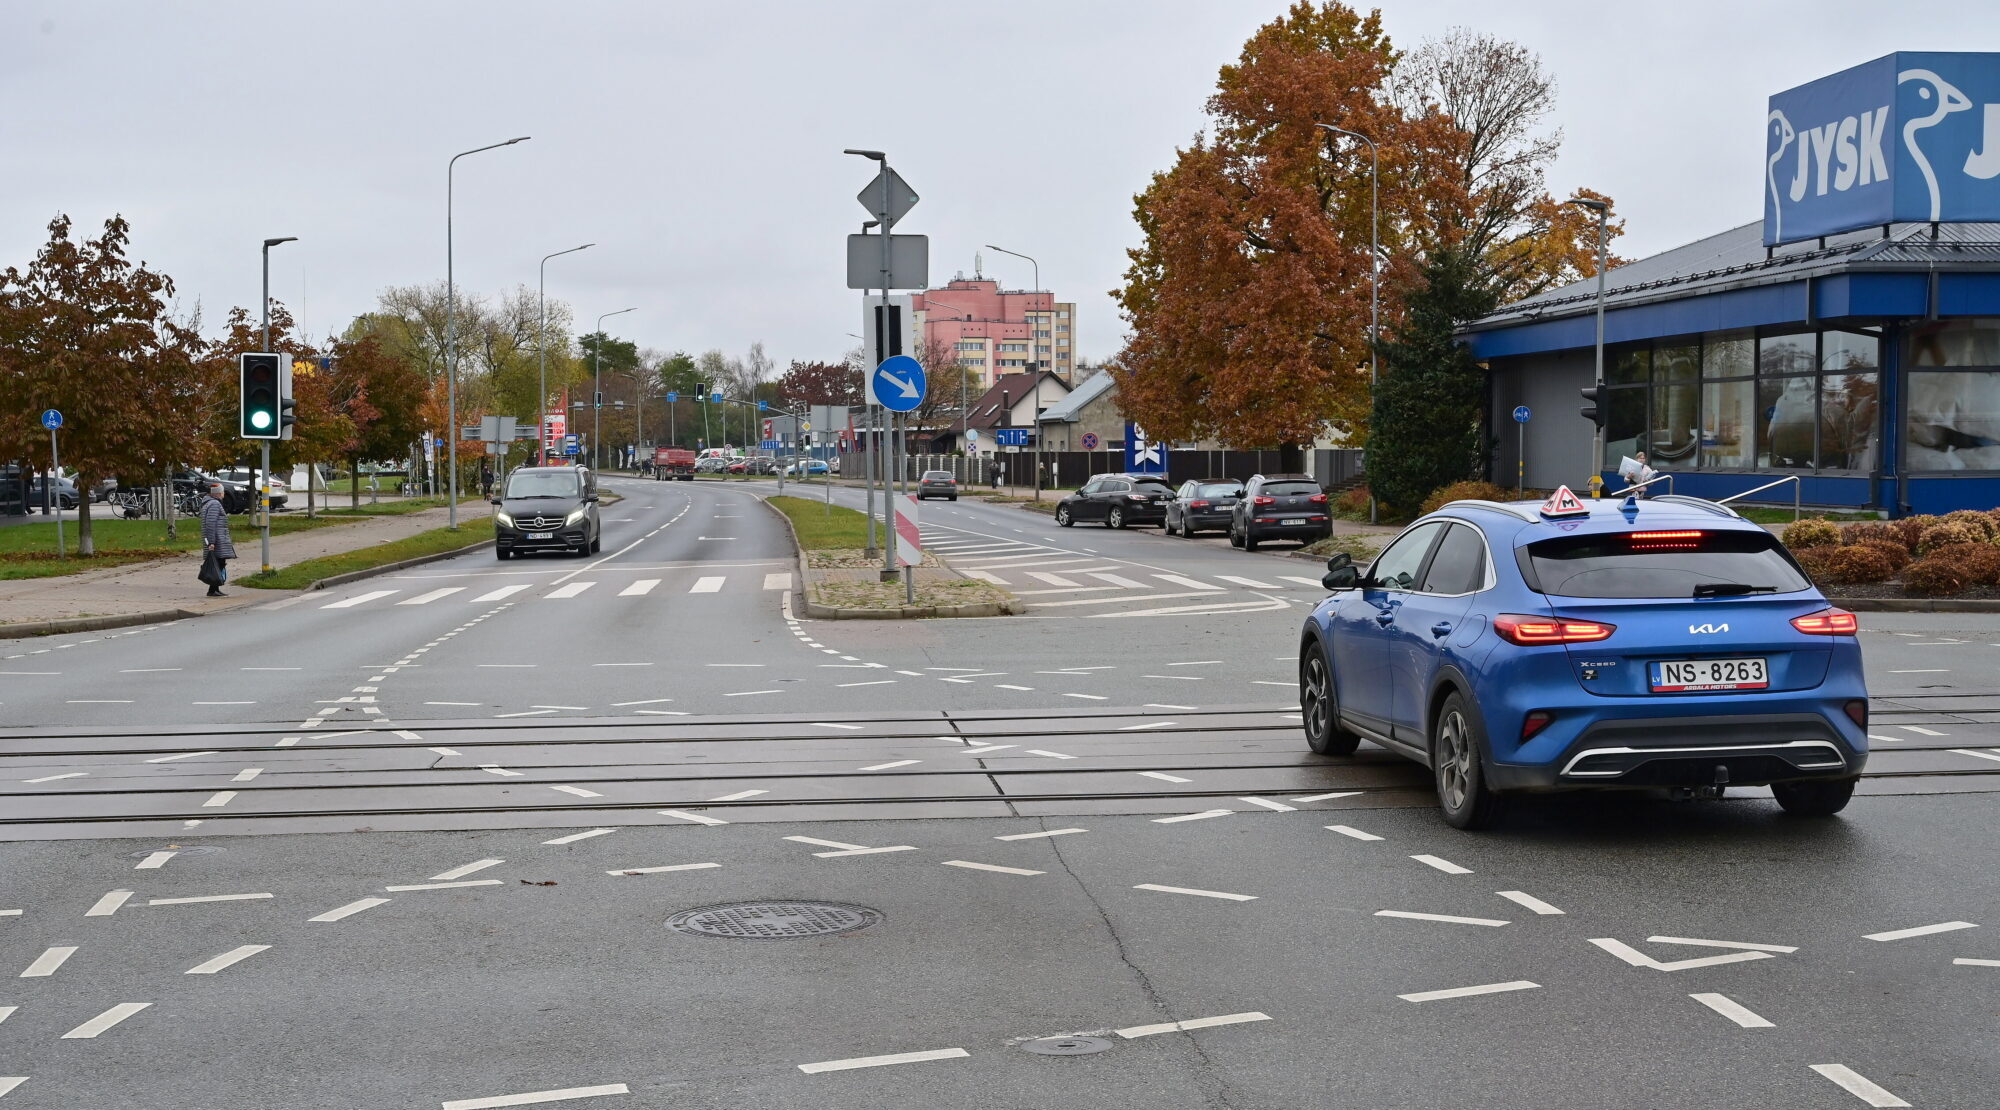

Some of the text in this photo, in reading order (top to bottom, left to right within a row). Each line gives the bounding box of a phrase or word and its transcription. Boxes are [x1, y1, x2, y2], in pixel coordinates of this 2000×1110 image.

[1790, 105, 1889, 202] JYSK
[1562, 499, 1575, 508] M
[1689, 623, 1729, 634] KIA
[1666, 661, 1763, 683] NS-8263
